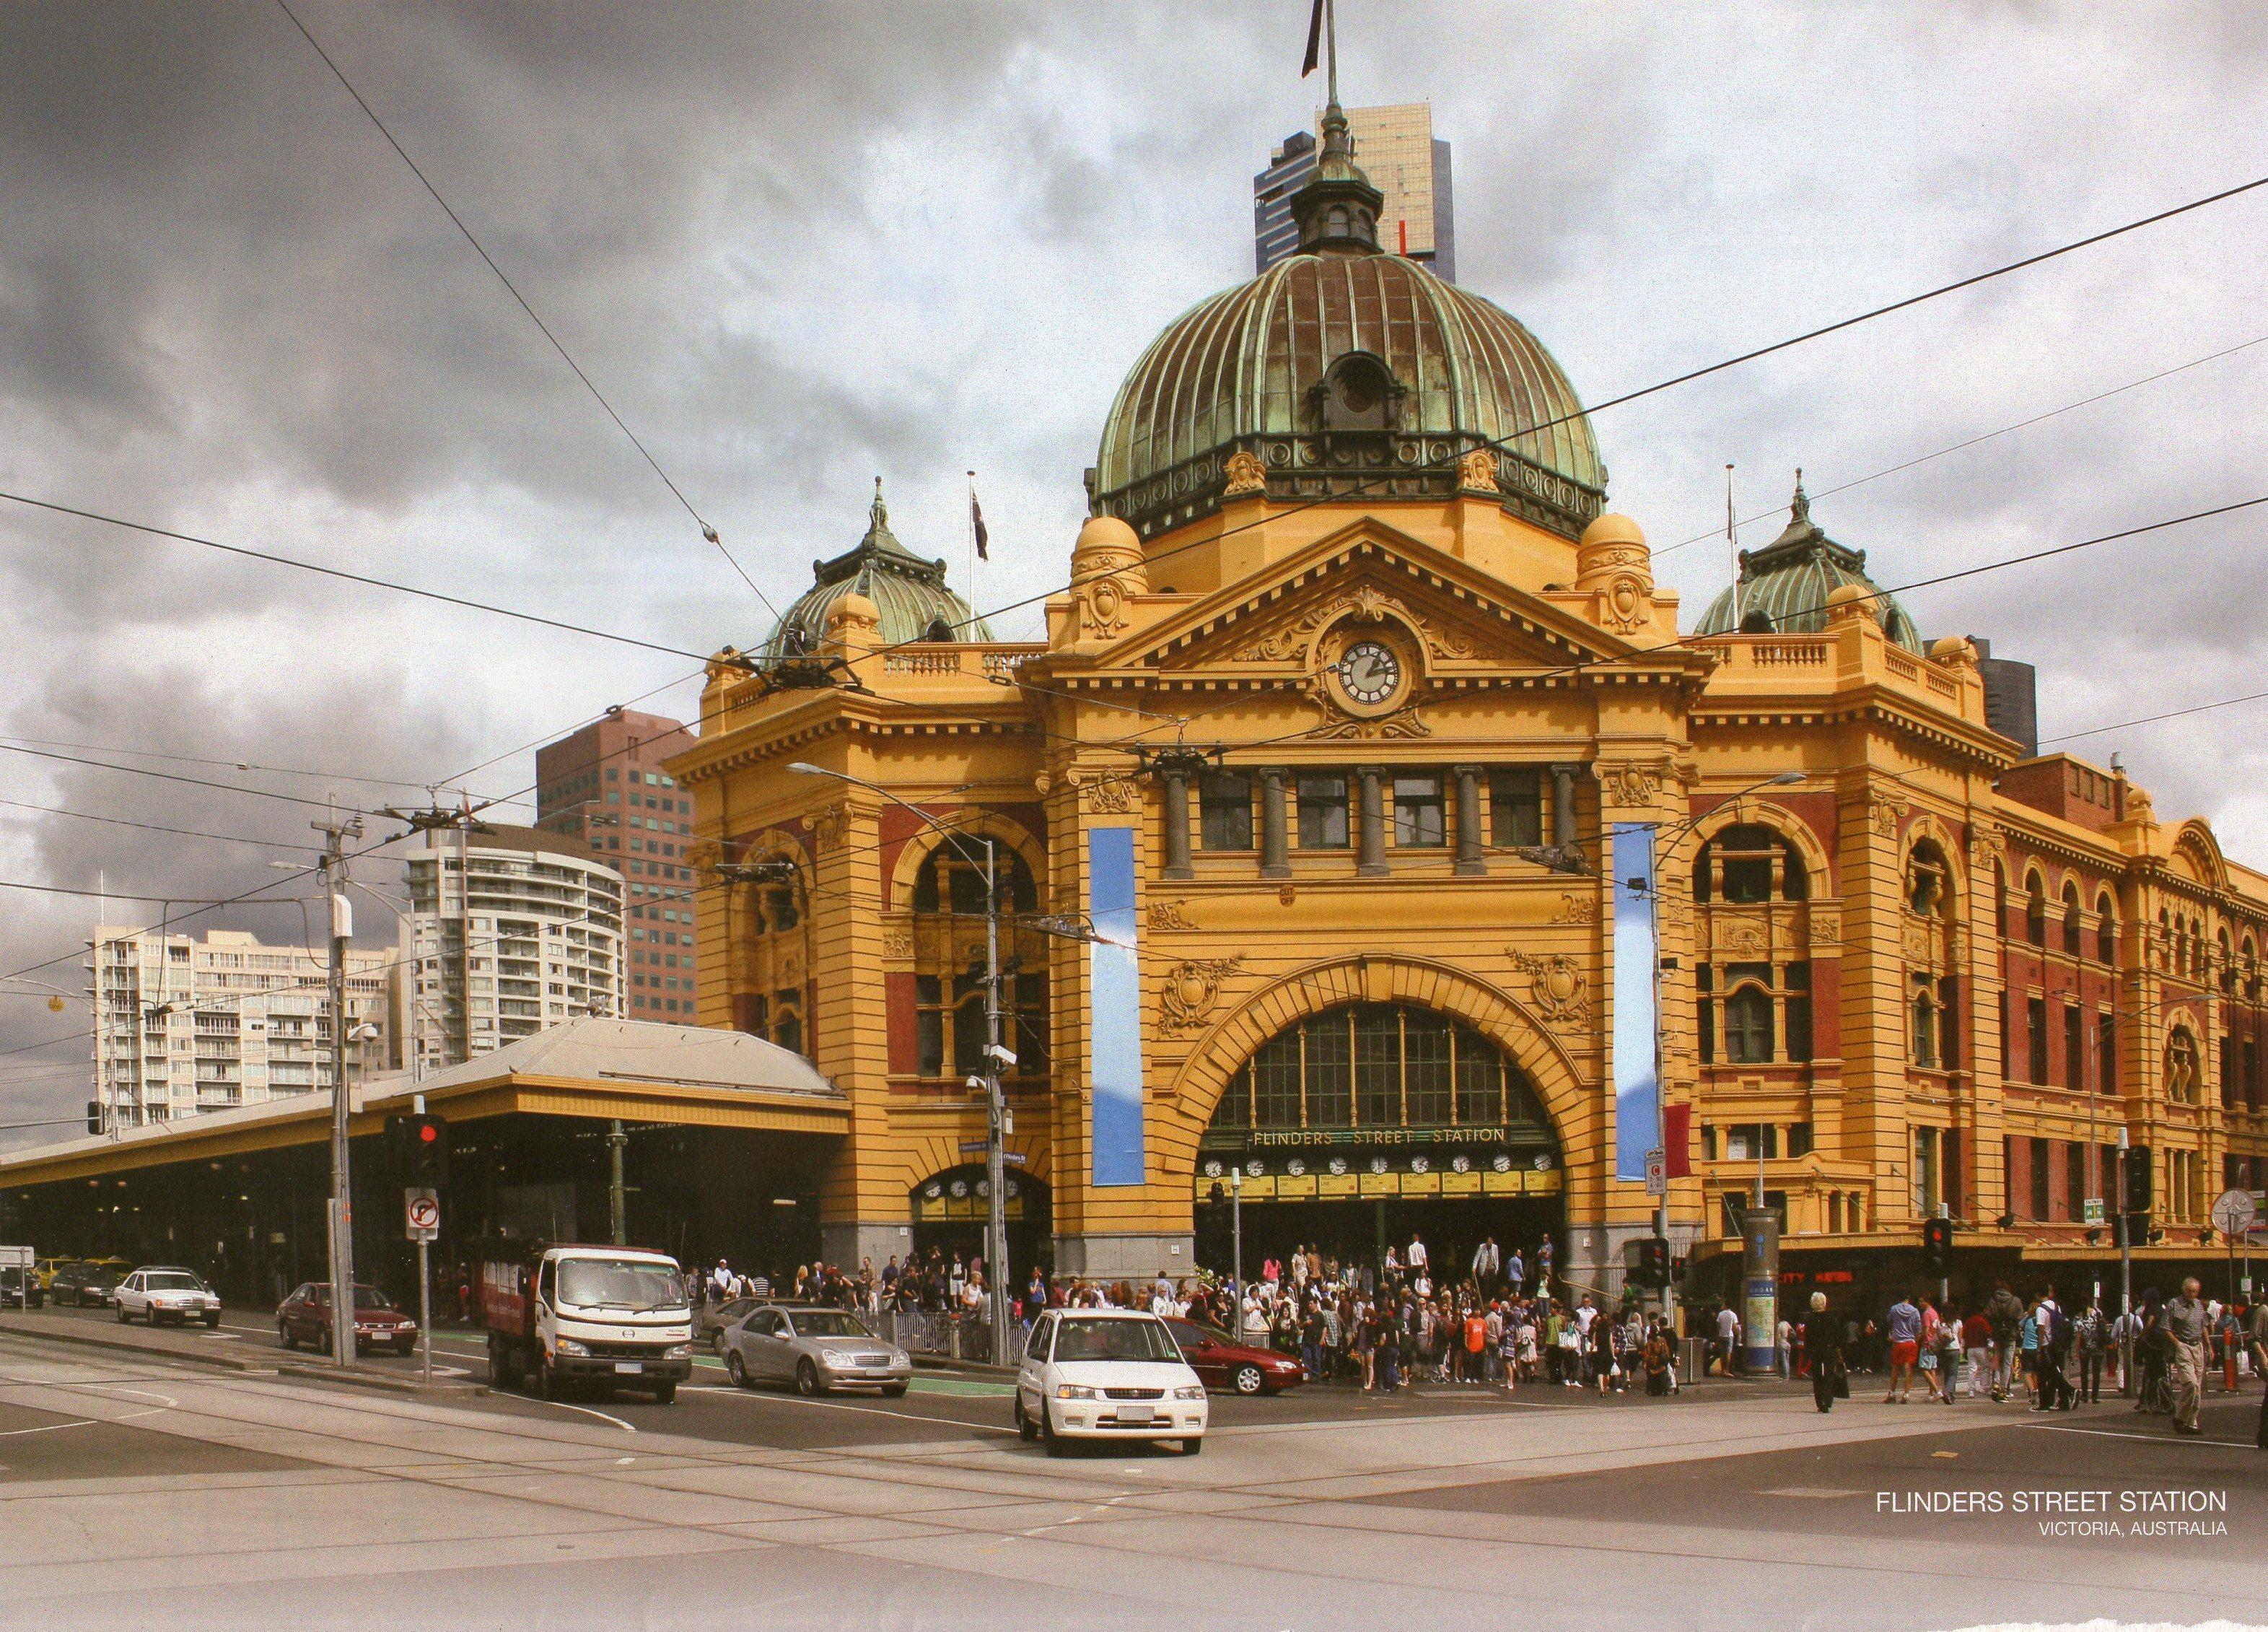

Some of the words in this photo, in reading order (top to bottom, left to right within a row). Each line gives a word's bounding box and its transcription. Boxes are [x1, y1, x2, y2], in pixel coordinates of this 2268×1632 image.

[1253, 1131, 1333, 1146] FLINDERS
[1353, 1130, 1414, 1144] STREET
[1432, 1128, 1505, 1143] STATION
